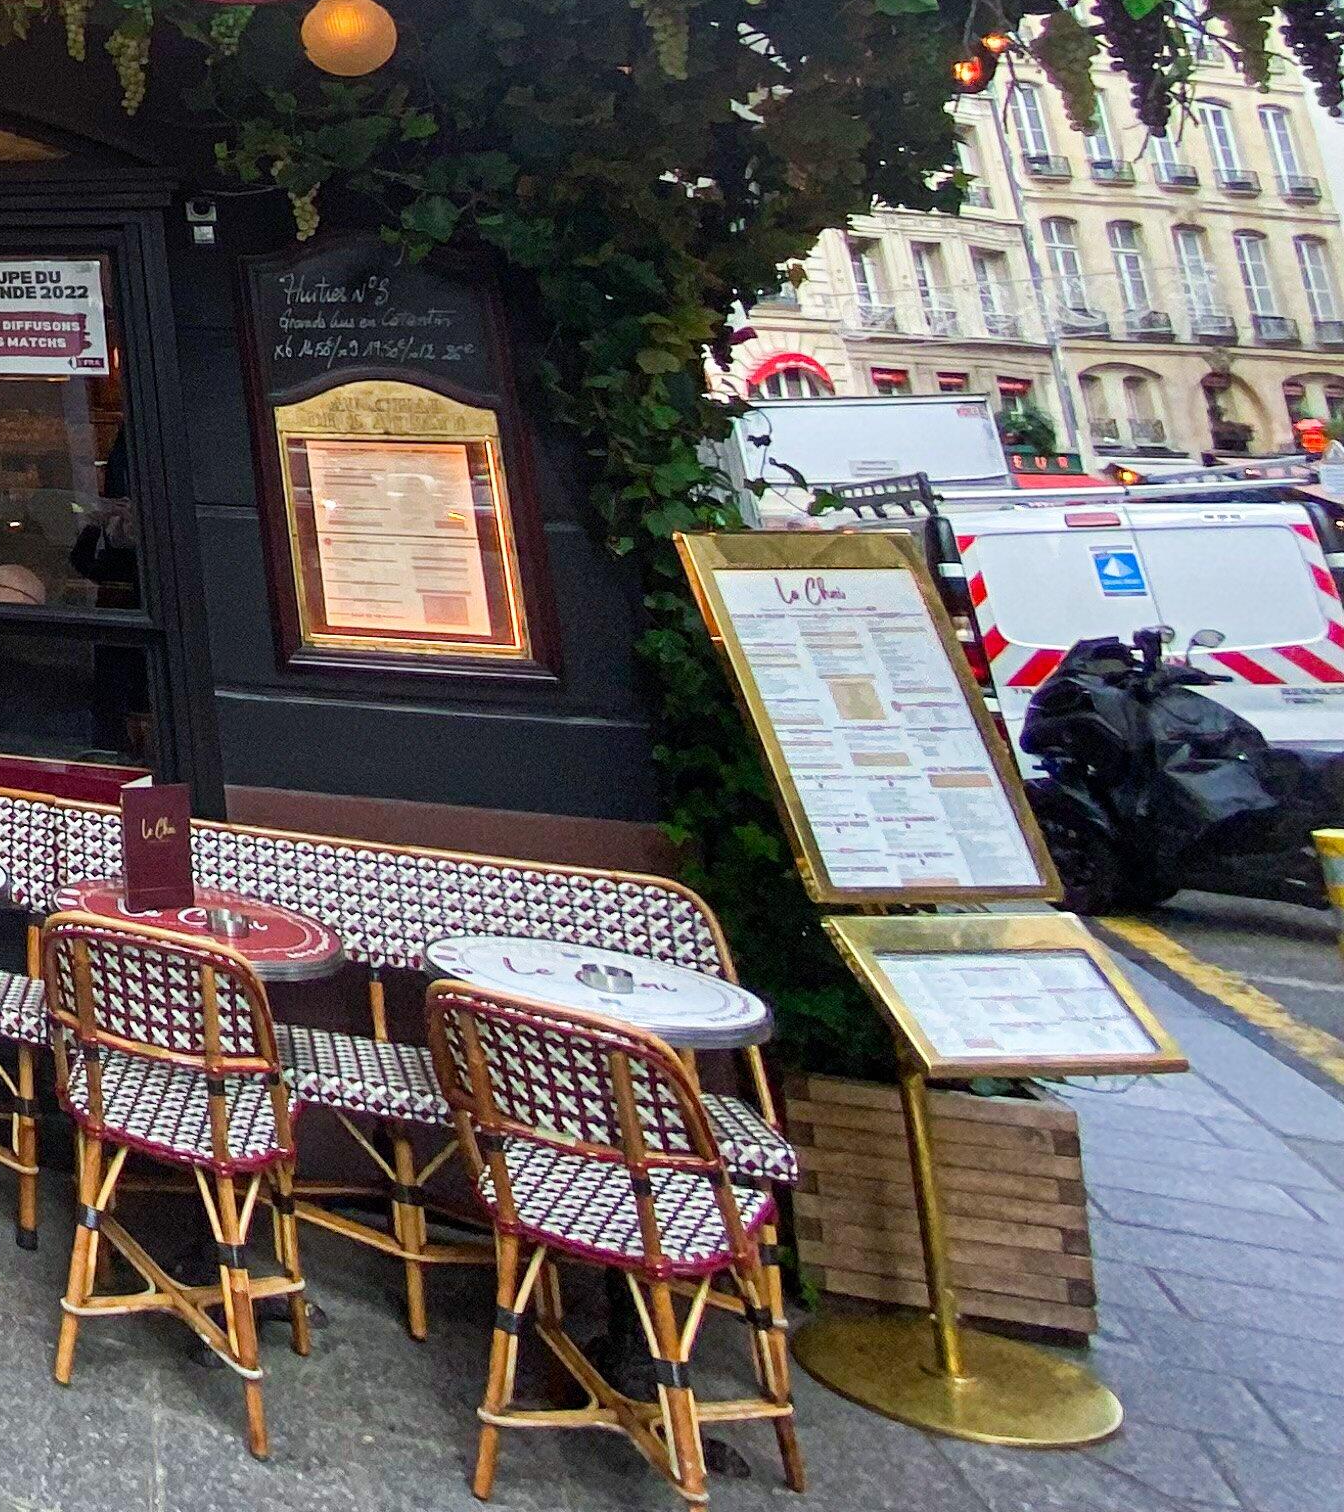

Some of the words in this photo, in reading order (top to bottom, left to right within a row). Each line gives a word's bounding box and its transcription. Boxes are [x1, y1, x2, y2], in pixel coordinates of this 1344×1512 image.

[35, 270, 62, 285] DU
[40, 285, 90, 300] 2022
[2, 319, 81, 332] DIFFUSONS
[7, 336, 67, 348] MATCHS
